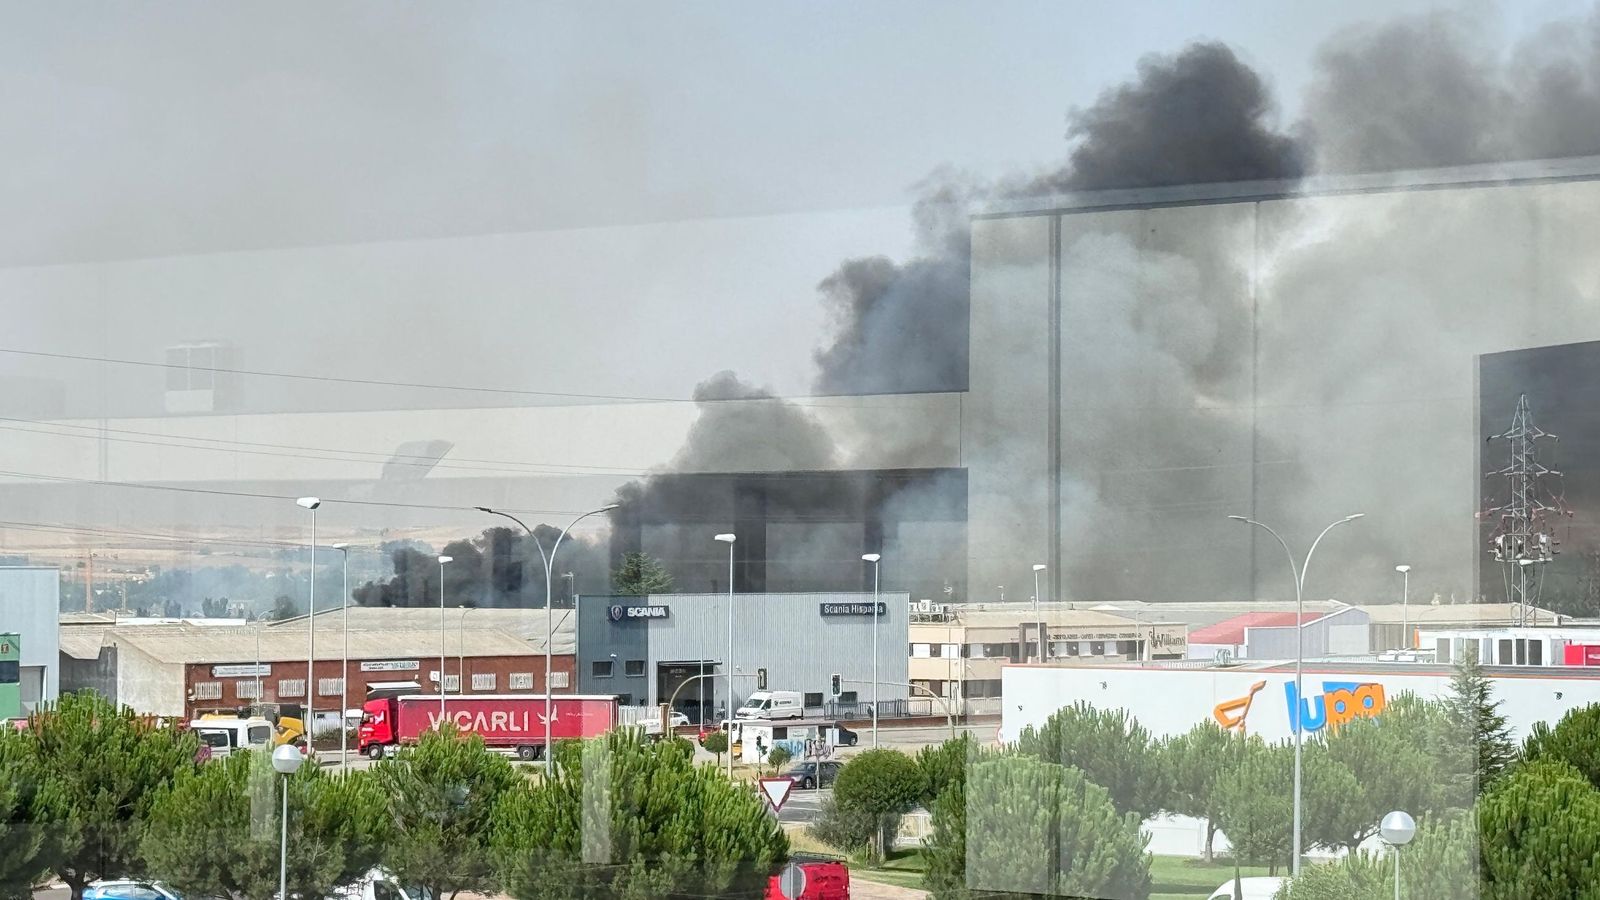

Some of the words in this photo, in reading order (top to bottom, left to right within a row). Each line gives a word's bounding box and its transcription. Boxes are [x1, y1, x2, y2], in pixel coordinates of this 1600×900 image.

[627, 607, 666, 617] SCANIA
[824, 604, 850, 614] Scania
[851, 604, 883, 614] Hispana
